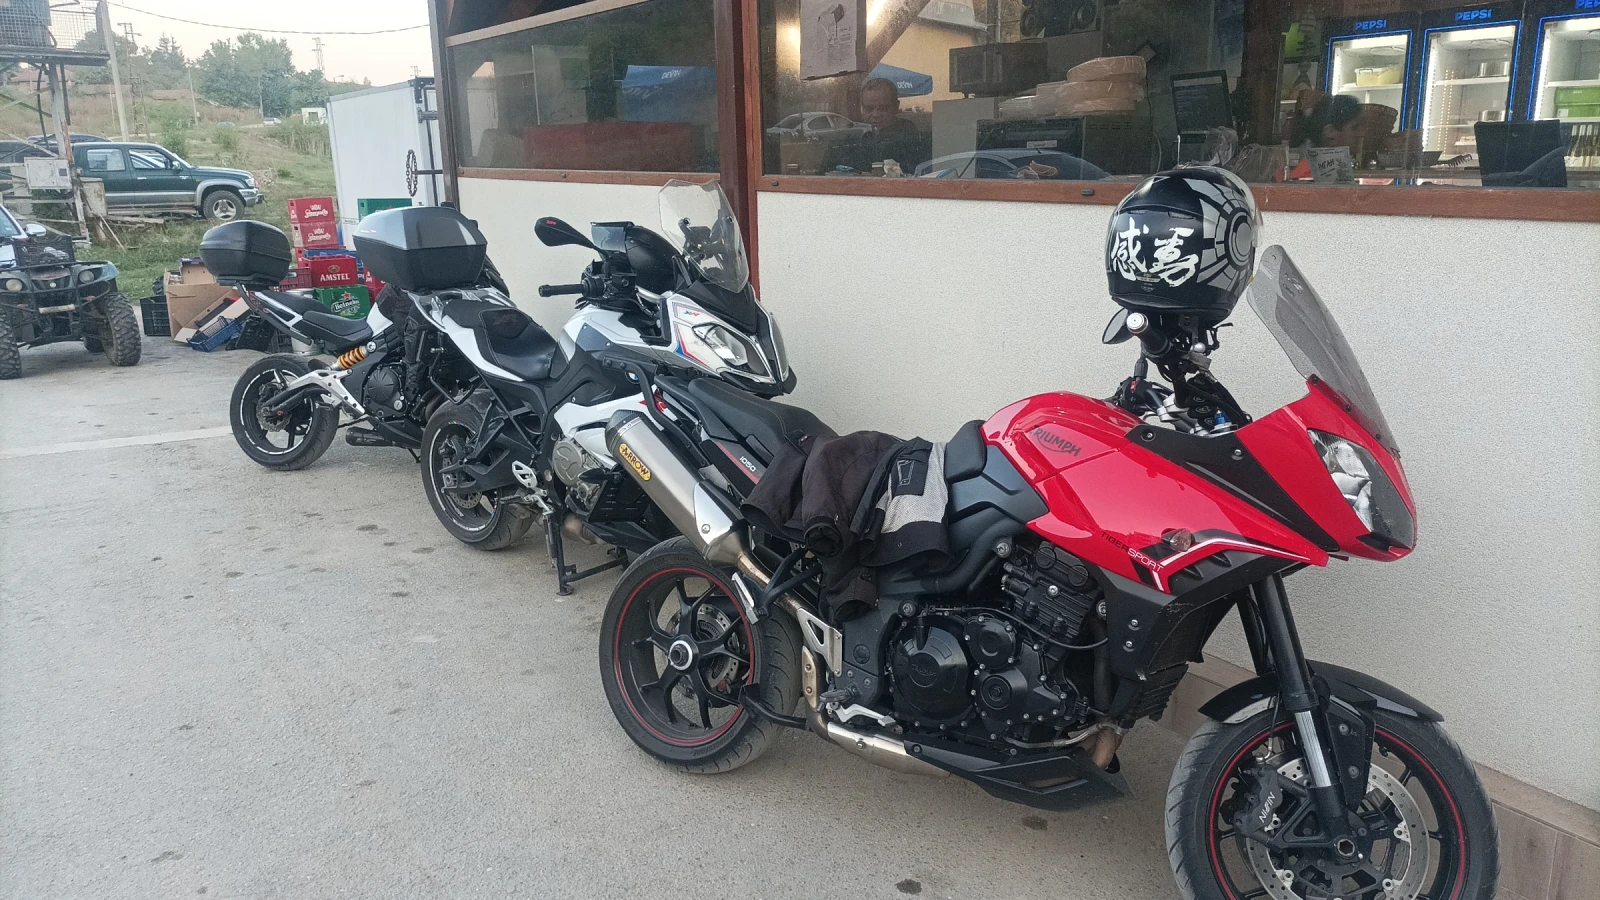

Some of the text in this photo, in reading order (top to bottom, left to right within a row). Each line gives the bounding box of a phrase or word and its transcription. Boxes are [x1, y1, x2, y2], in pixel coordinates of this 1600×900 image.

[1455, 9, 1492, 21] PEPSI
[1355, 20, 1387, 30] PEPSI
[320, 273, 350, 282] AMSTEL
[621, 447, 649, 475] ARROW
[739, 455, 757, 472] 1050
